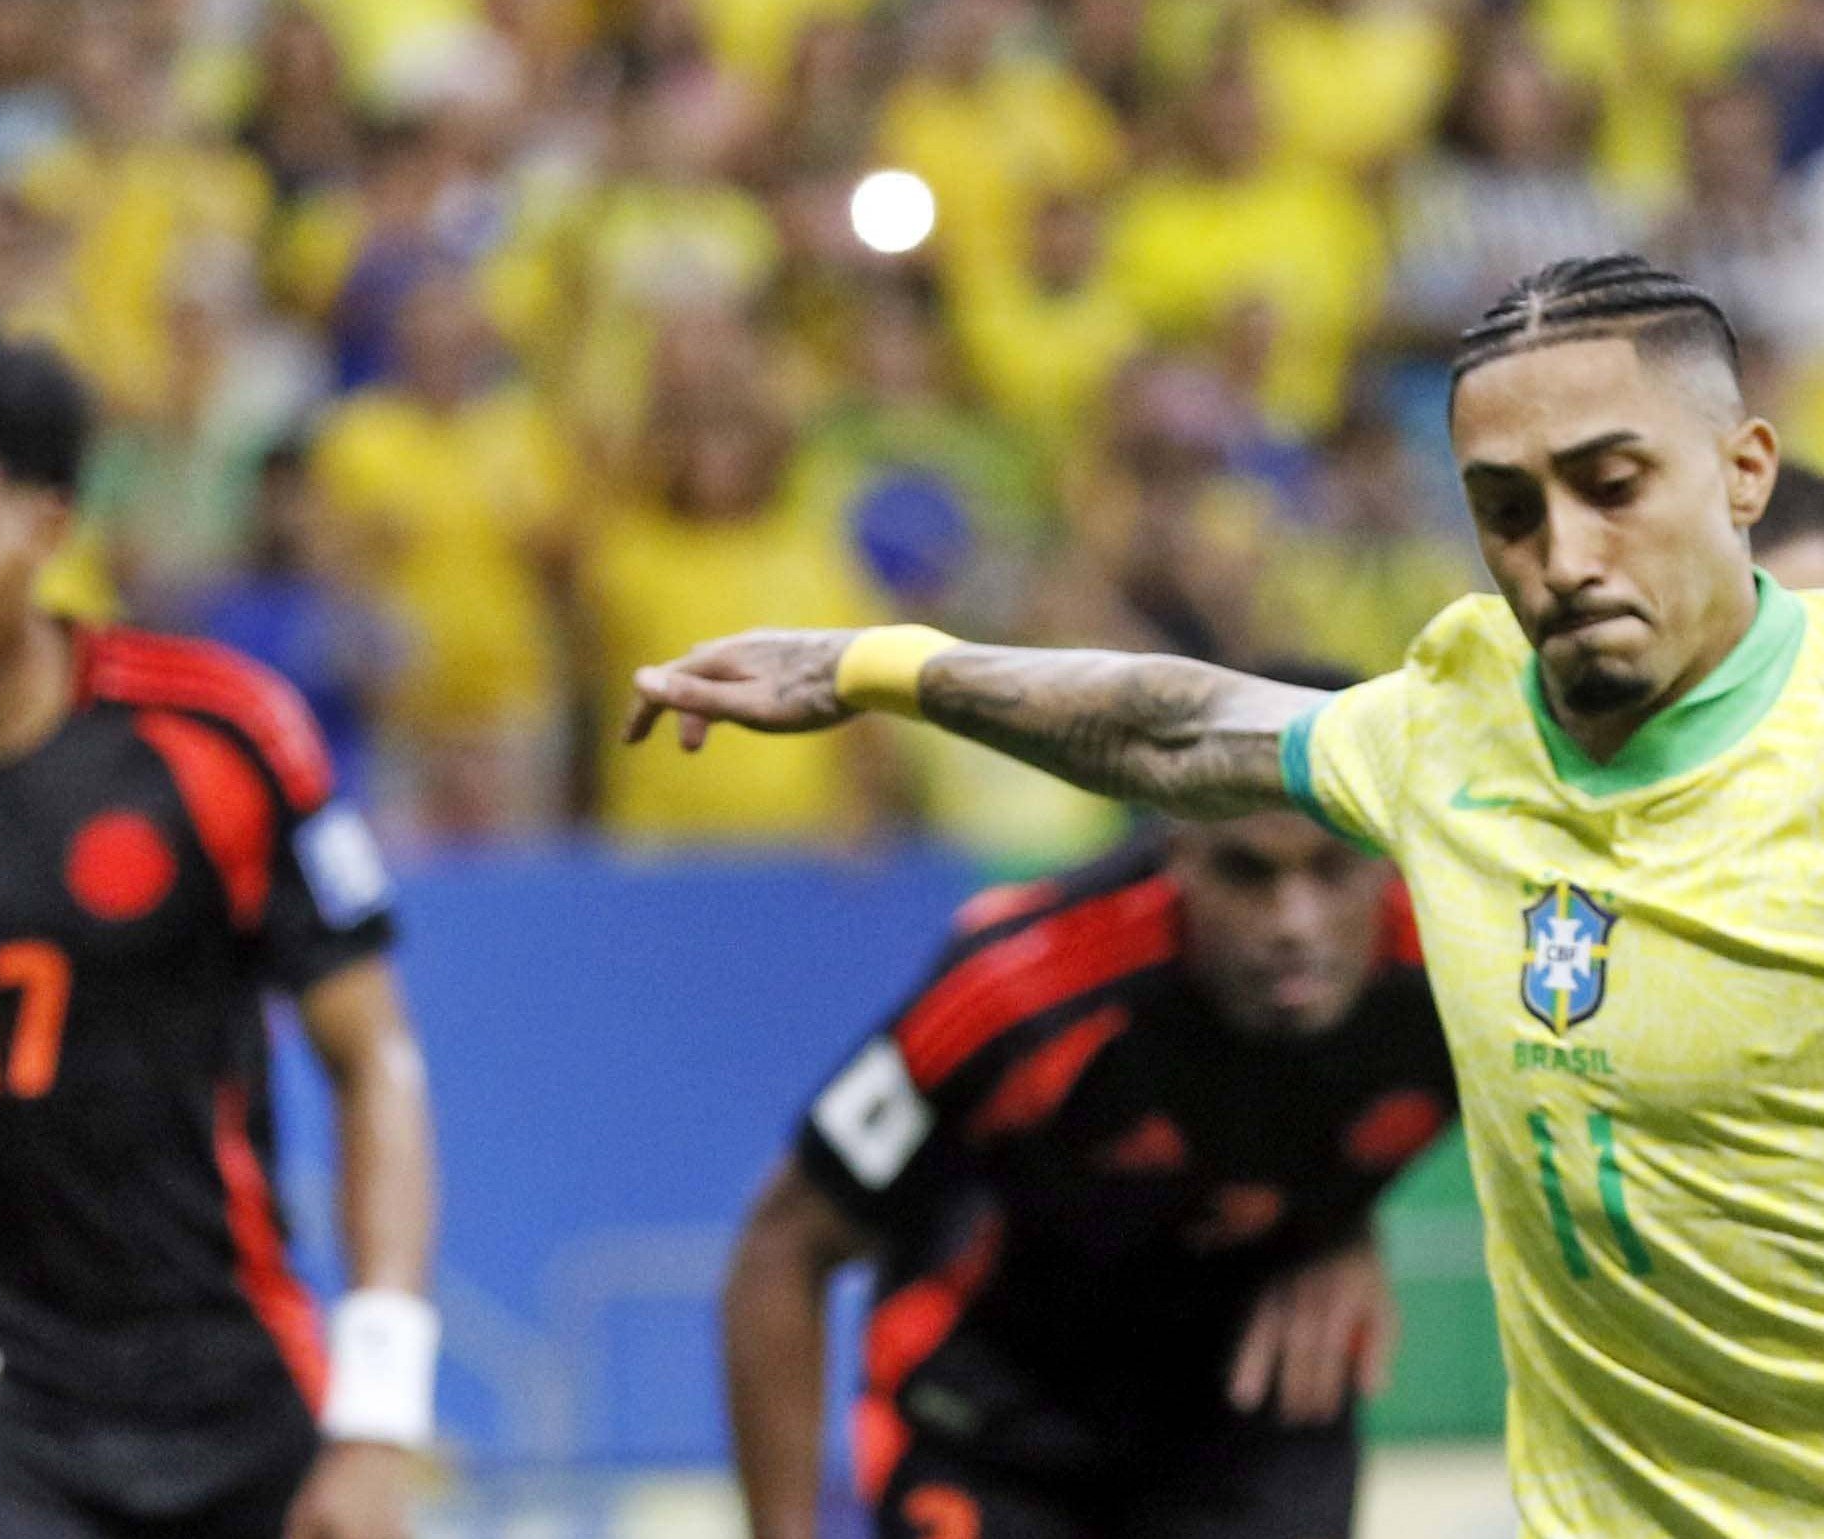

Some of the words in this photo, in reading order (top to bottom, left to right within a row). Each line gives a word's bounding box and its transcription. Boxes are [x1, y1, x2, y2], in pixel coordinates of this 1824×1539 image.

[1545, 944, 1576, 962] CBF
[1512, 1040, 1614, 1075] BRASIL
[1525, 1111, 1653, 1280] 11
